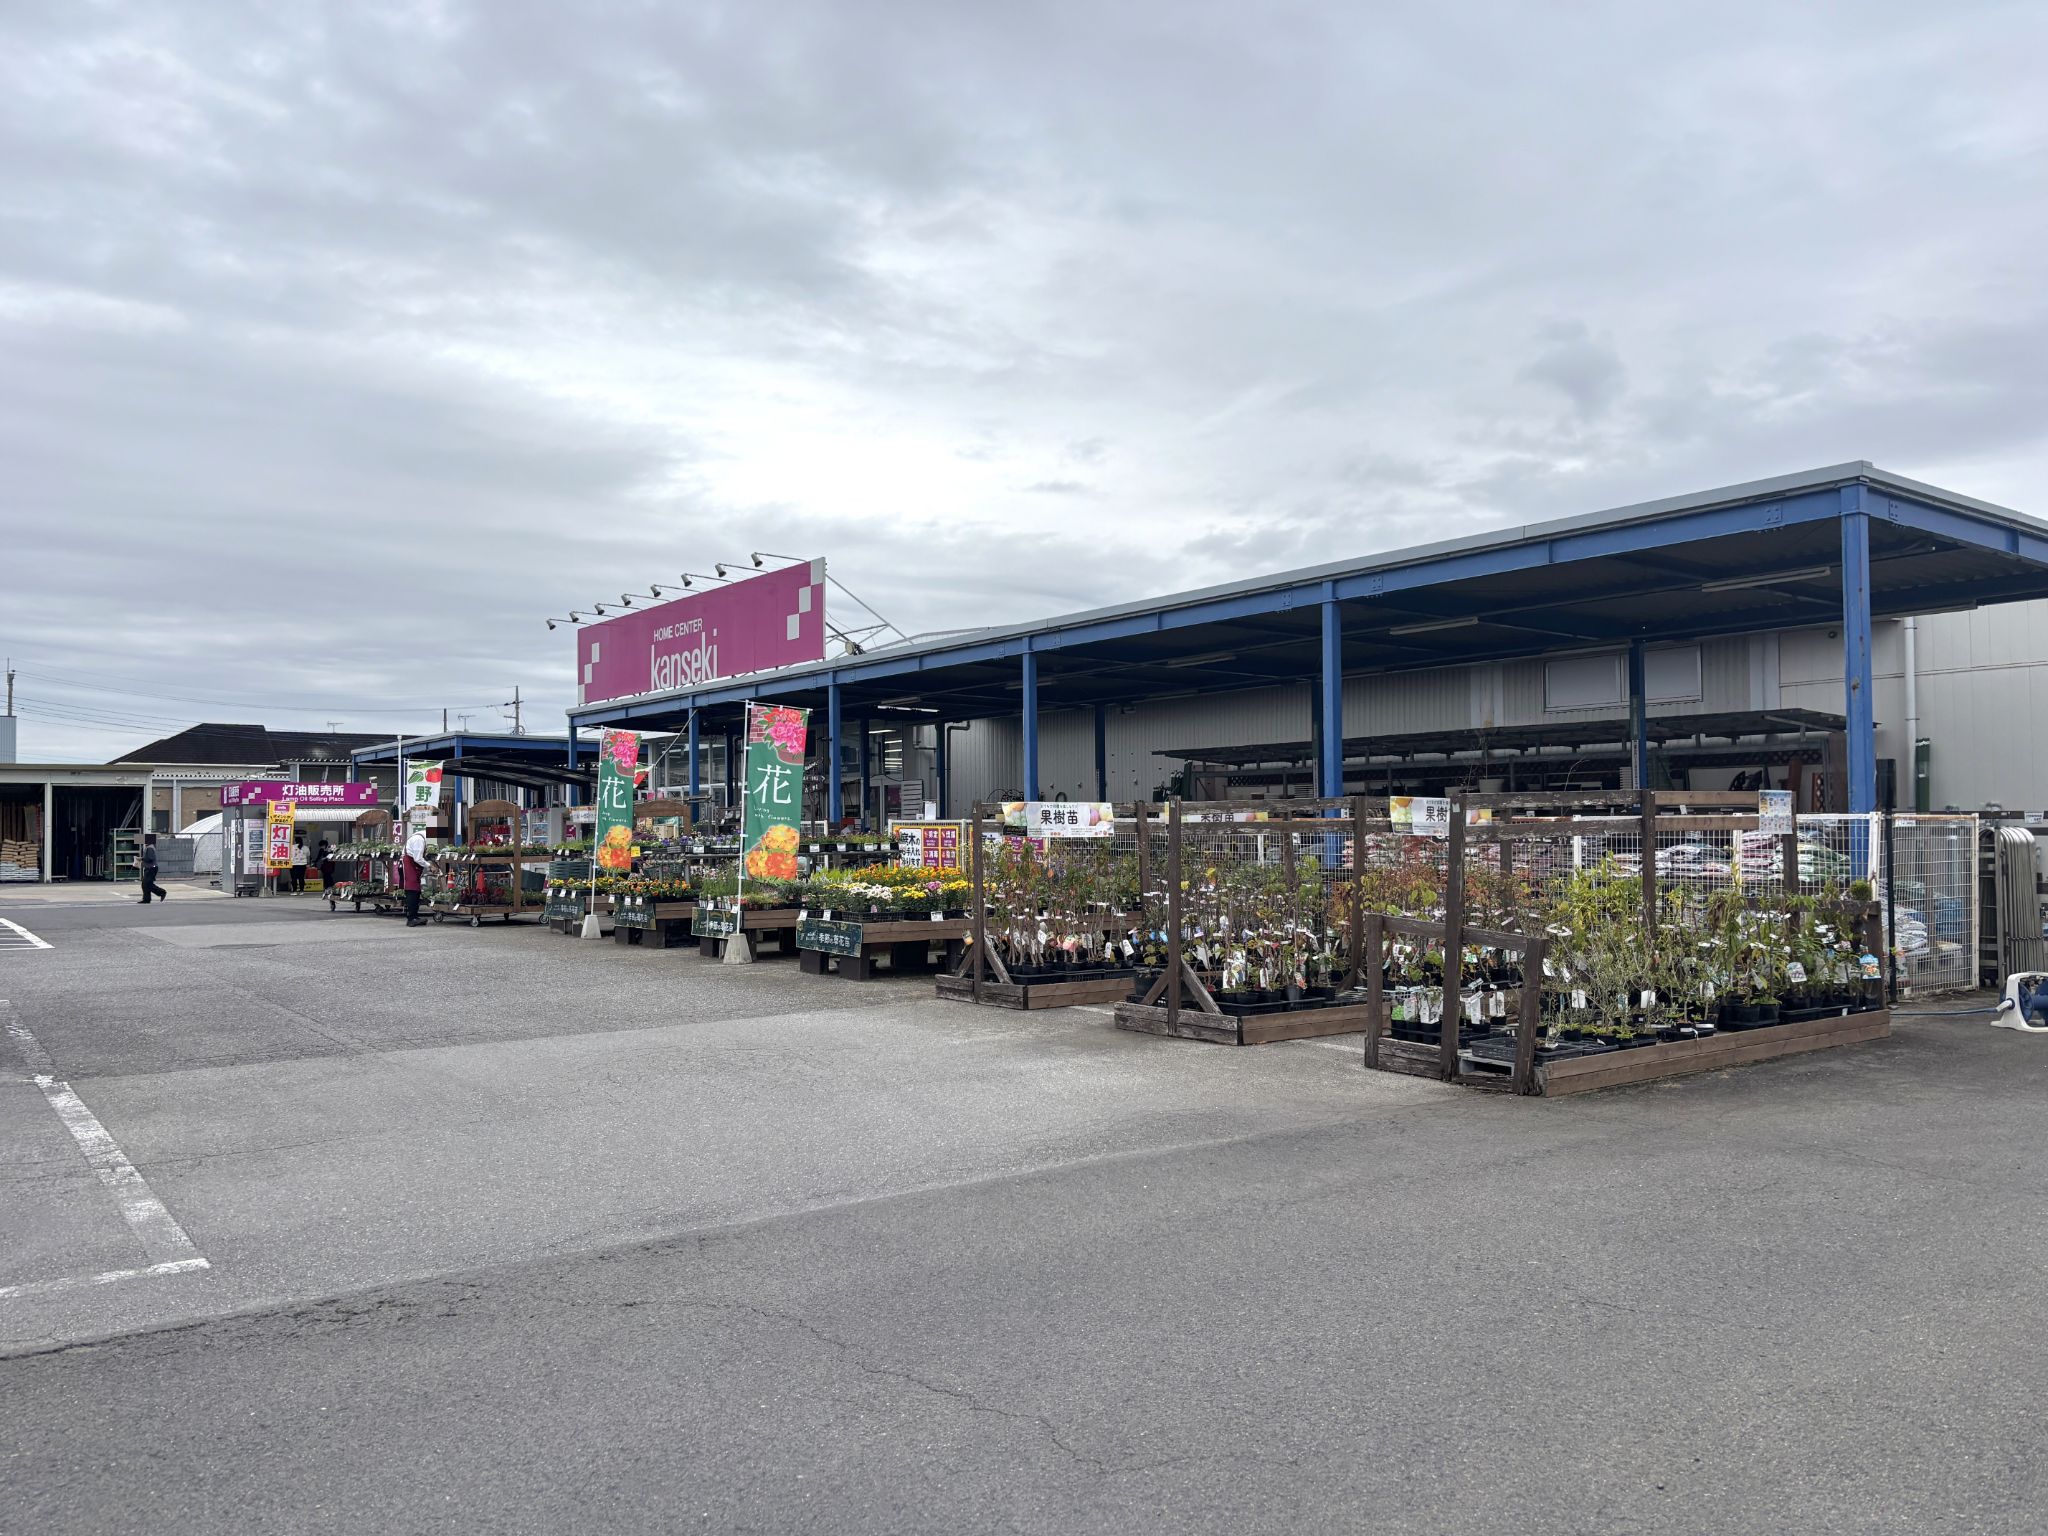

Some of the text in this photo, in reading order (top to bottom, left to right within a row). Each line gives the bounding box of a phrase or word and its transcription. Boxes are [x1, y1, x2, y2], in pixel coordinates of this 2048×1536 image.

[653, 617, 703, 643] HOME CENTER
[651, 628, 718, 691] kanseki
[281, 784, 345, 797] 灯油販売所
[601, 776, 627, 809] 花
[753, 764, 792, 804] 花
[281, 796, 298, 804] Lamp
[1041, 809, 1078, 825] 果樹苗
[272, 824, 290, 859] 灯油
